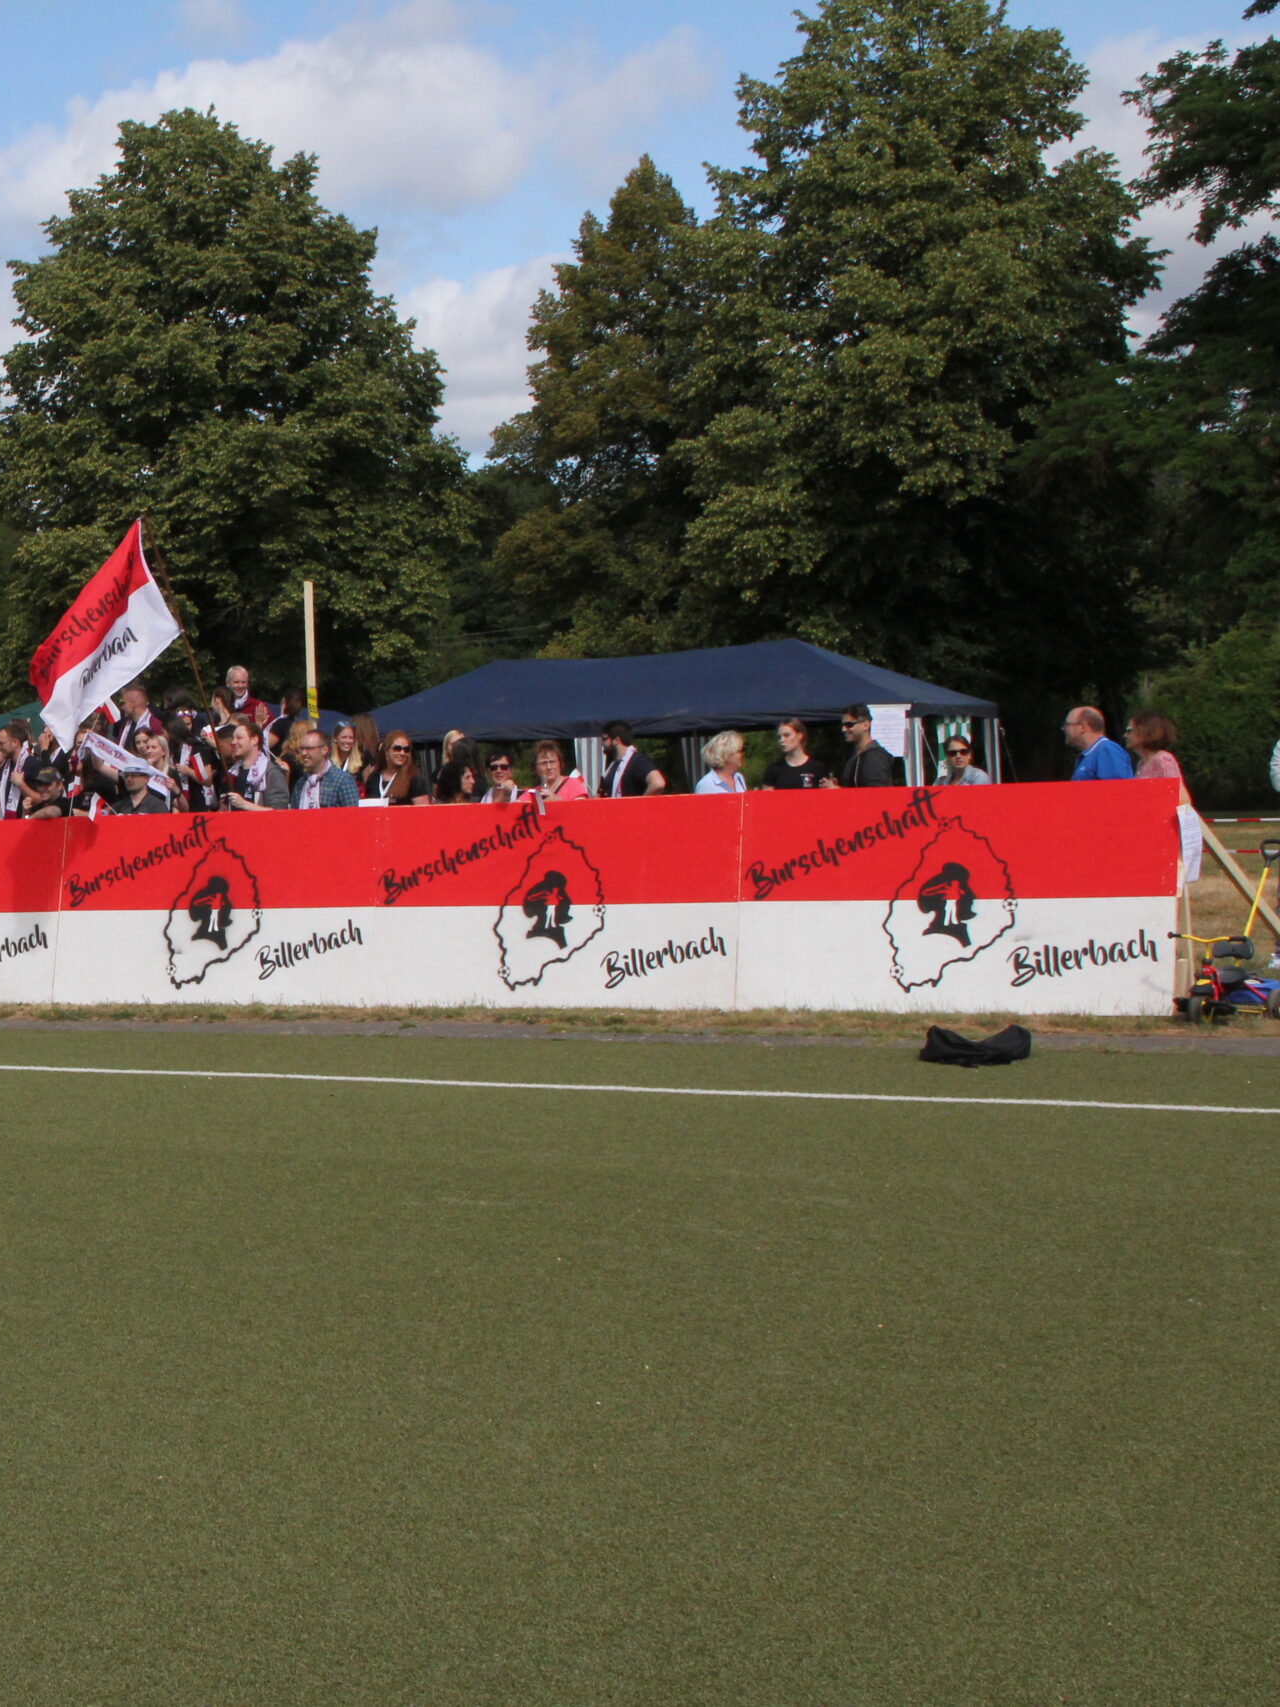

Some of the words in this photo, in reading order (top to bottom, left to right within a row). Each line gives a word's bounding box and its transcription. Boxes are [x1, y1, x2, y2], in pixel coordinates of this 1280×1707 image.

[65, 815, 216, 907] Burschenschaft
[378, 804, 545, 905] Burschenschaft
[746, 789, 943, 900] Burschenschaft
[255, 919, 363, 981] Billerbach
[600, 926, 728, 989] Billerbach
[1006, 929, 1159, 988] Billerbach
